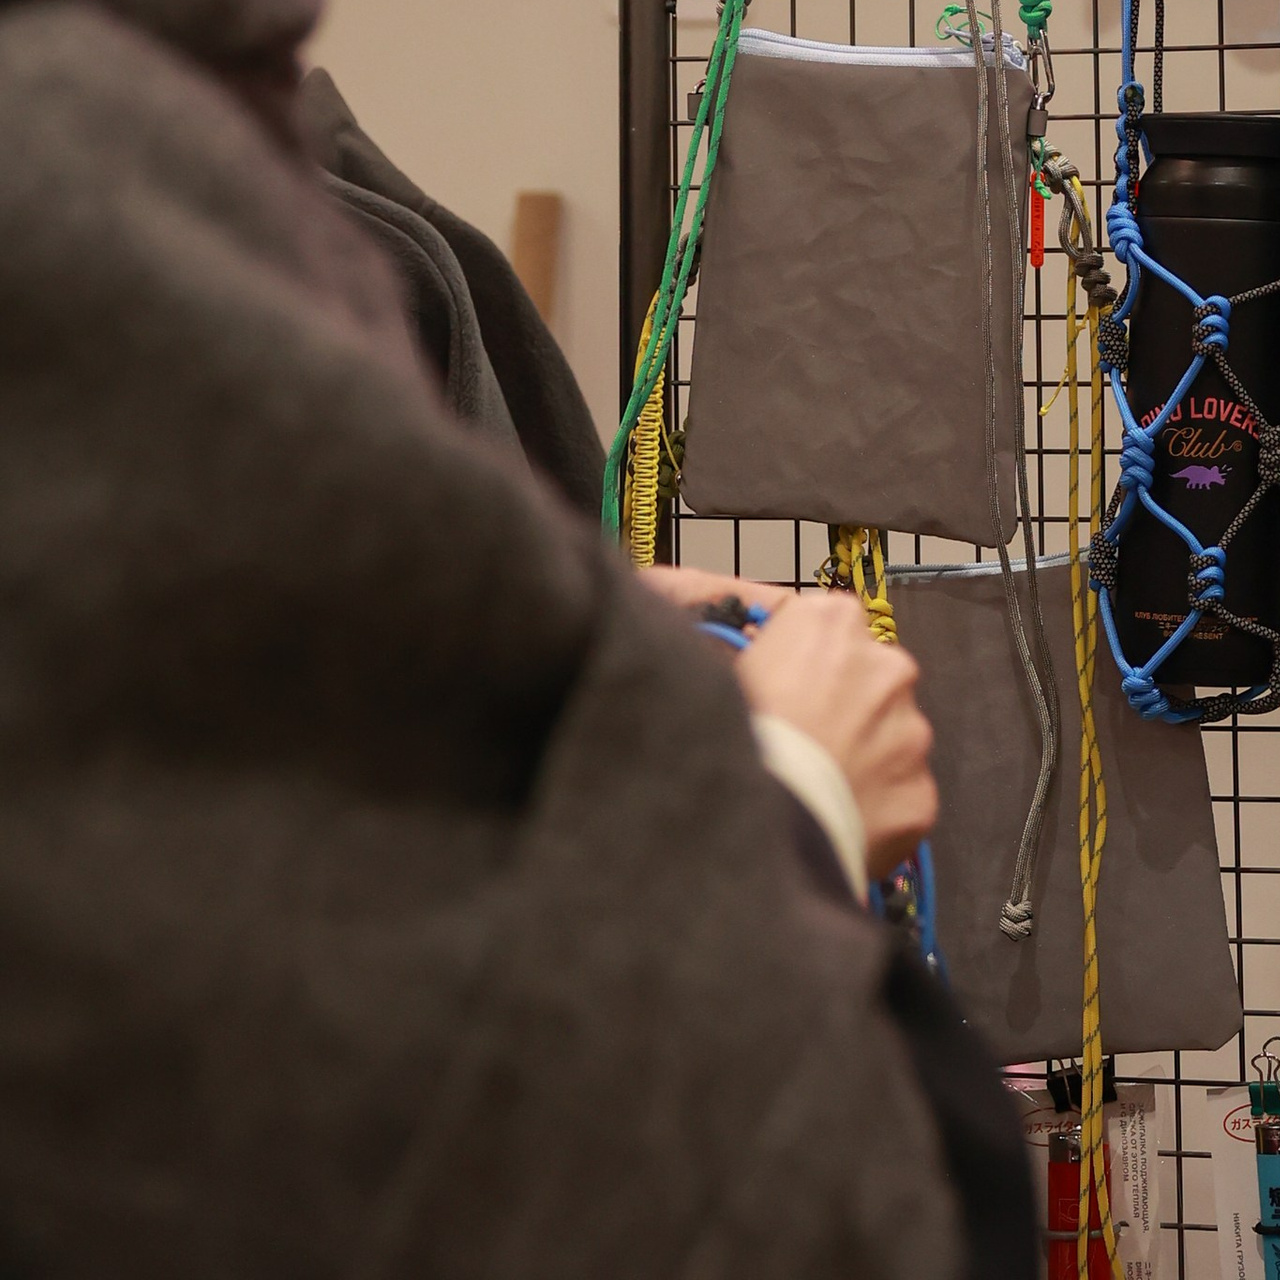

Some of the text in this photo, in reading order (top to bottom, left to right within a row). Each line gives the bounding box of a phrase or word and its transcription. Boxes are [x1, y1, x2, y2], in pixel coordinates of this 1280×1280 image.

[1162, 427, 1242, 458] Club
[1130, 1140, 1138, 1151] ОТ
[1131, 1152, 1139, 1181] ЭТОГО
[1233, 1213, 1242, 1248] НИКИТА
